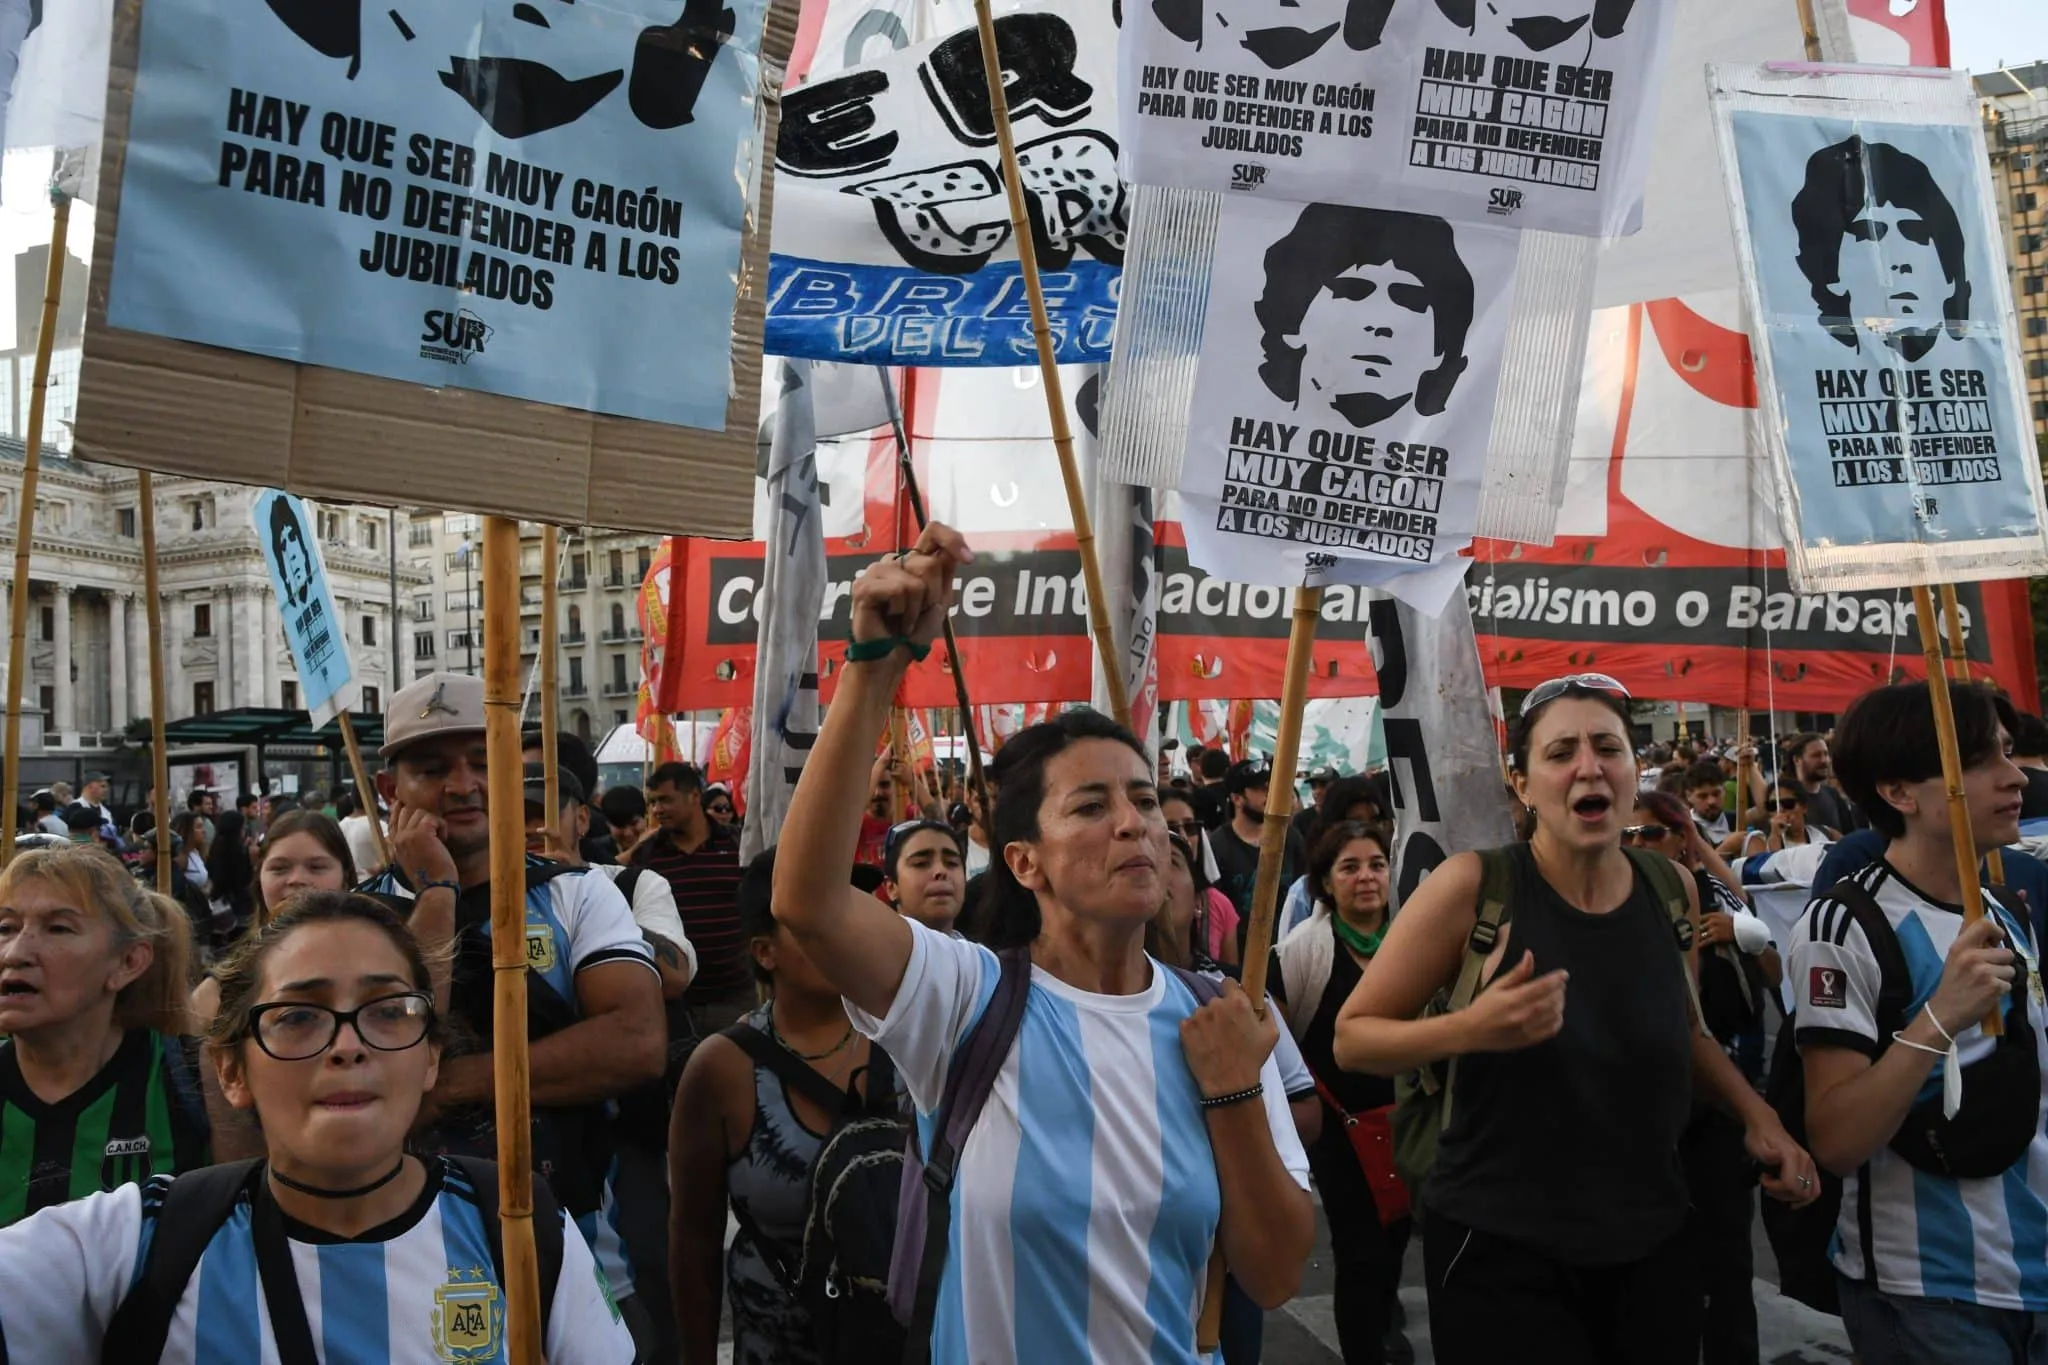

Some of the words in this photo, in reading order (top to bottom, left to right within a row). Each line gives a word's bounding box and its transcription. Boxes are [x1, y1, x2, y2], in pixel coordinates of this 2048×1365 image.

[1142, 65, 1179, 90] HAY
[1183, 69, 1219, 94] QUE
[1224, 73, 1260, 99] SER
[1264, 78, 1308, 104] MUY
[1312, 83, 1375, 111] CAGÓN
[1423, 47, 1486, 83] HAY
[1491, 55, 1550, 92] QUE
[1555, 64, 1613, 101] SER
[1138, 92, 1186, 118] PARA
[1192, 97, 1217, 120] NO
[1223, 100, 1315, 133] DEFENDER
[1319, 112, 1332, 135] A
[1338, 114, 1373, 138] LOS
[1419, 82, 1494, 120] MUY
[1202, 126, 1303, 157] JUBILADOS
[1414, 116, 1468, 143] PARA
[1473, 124, 1502, 146] NO
[1506, 128, 1602, 161] DEFENDER
[227, 88, 310, 146] HAY
[321, 112, 397, 170] QUE
[407, 133, 476, 187] SER
[486, 151, 563, 210] MUY
[572, 178, 683, 239] CAGÓN
[1232, 163, 1266, 184] SUR
[1412, 142, 1429, 165] A
[1433, 144, 1476, 172] LOS
[1479, 150, 1597, 189] JUBILADOS
[218, 141, 326, 207] PARA
[339, 169, 392, 221] NO
[403, 185, 576, 265] DEFENDER
[584, 231, 606, 272] A
[618, 238, 681, 285] LOS
[1488, 188, 1523, 209] SUR
[360, 231, 555, 310] JUBILADOS
[420, 310, 485, 353] SUR
[837, 315, 986, 358] DEL
[1816, 369, 1868, 398] HAY
[1879, 368, 1933, 399] QUE
[1939, 368, 1987, 397] SER
[1822, 402, 1888, 433] MUY
[1229, 416, 1299, 453] HAY
[1308, 429, 1376, 466] QUE
[1383, 441, 1449, 477] SER
[1827, 437, 1878, 457] PARA
[1881, 435, 1903, 456] NO
[1911, 435, 1997, 457] DEFENDER
[1228, 450, 1309, 491] MUY
[1836, 462, 1850, 485] A
[1854, 461, 1892, 484] LOS
[1221, 484, 1279, 511] PARA
[1287, 496, 1317, 517] NO
[1323, 500, 1438, 536] DEFENDER
[1218, 508, 1236, 531] A
[1244, 511, 1290, 538] LOS
[1295, 521, 1431, 562] JUBILADOS
[1676, 590, 1709, 628] o
[1726, 585, 1972, 640] Barbare
[452, 1303, 486, 1337] AFA
